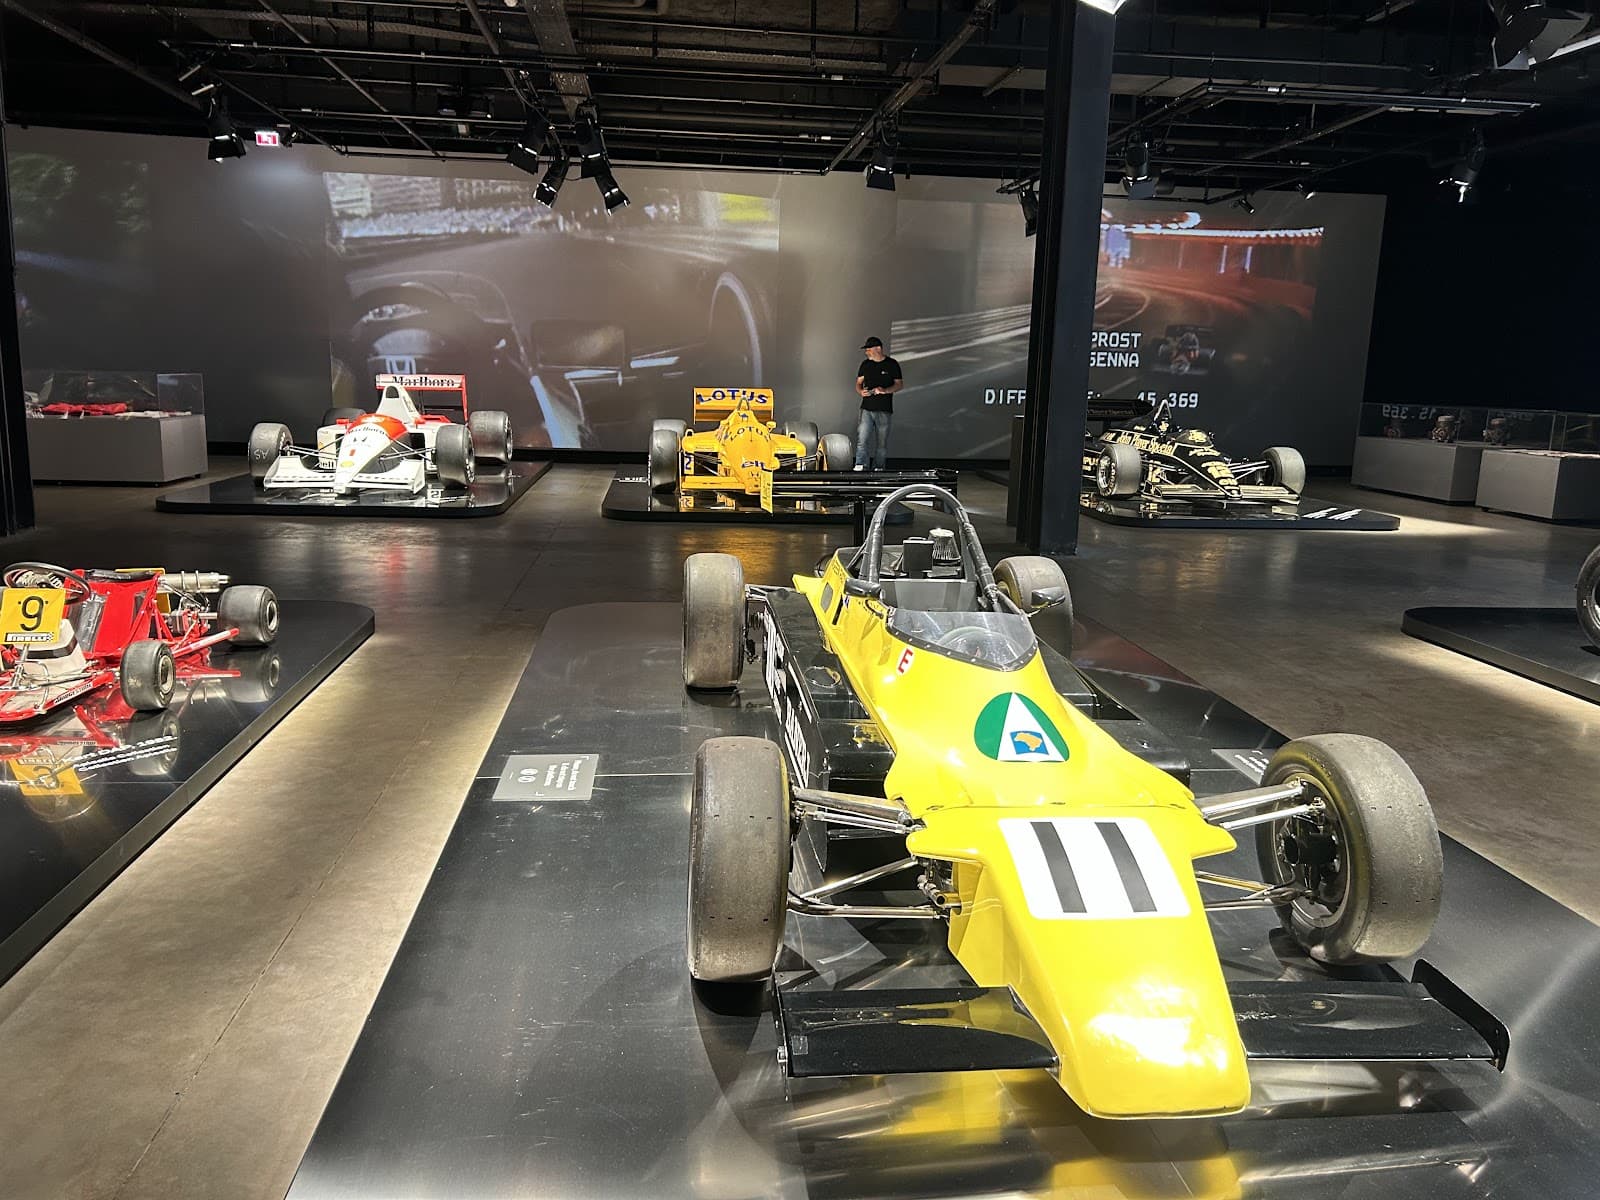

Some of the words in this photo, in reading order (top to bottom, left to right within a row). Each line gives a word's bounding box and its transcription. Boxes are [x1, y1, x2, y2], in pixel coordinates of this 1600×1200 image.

[1092, 332, 1142, 348] PROST
[1090, 352, 1140, 368] SENNA
[392, 375, 455, 387] Marlboro
[696, 389, 768, 404] LOTUS
[20, 595, 45, 632] 9
[897, 648, 913, 674] E
[1029, 821, 1158, 913] 11
